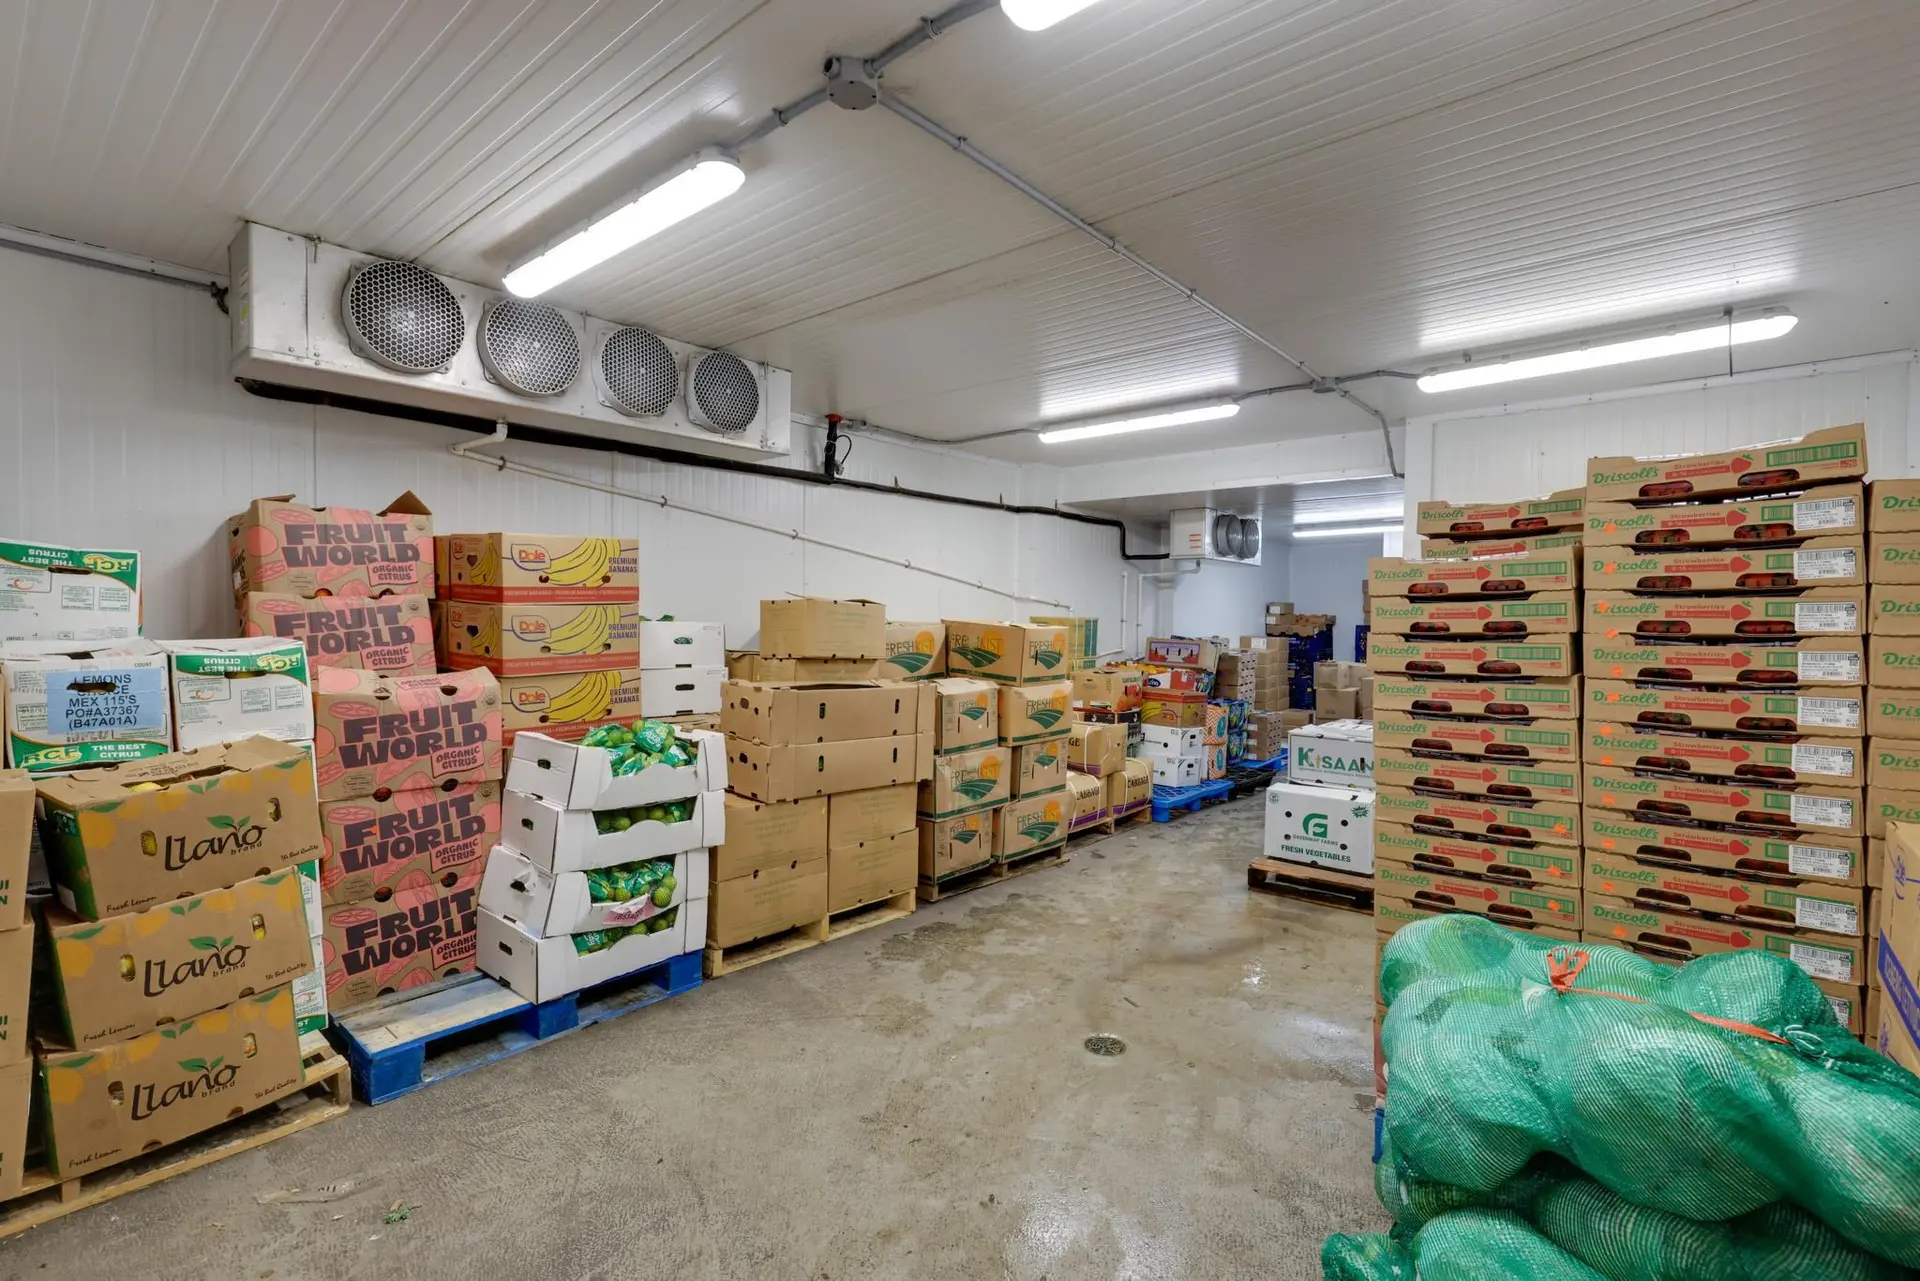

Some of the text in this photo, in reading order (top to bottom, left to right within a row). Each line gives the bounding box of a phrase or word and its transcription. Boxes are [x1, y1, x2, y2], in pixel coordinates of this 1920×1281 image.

[1673, 460, 1725, 469] Strawberries
[1592, 467, 1659, 484] Driscoll's
[1421, 510, 1465, 520] Driscoll's
[1589, 514, 1656, 530] Drscoll's
[283, 523, 408, 546] FRUIT
[28, 548, 68, 559] CITRUS
[281, 543, 421, 568] WORLD
[518, 549, 546, 561] Dole
[1426, 547, 1469, 557] Driscoll's
[20, 556, 74, 567] THE BEST
[608, 557, 638, 565] PREMIUM
[1592, 558, 1659, 573] Dscoll's
[372, 564, 414, 574] ORGANIC
[378, 571, 412, 581] CITRUS
[608, 565, 638, 573] BANANAS
[1373, 568, 1425, 580] Driscoll's
[1375, 606, 1425, 617] Driscoll's
[273, 605, 403, 638] FRUIT
[519, 620, 546, 631] Dole
[608, 623, 637, 631] PREMIUM
[608, 631, 637, 640] BANANAS
[365, 646, 409, 661] ORGANIC
[1371, 645, 1420, 656] Driscoll's
[1592, 648, 1660, 661] Driscoll's
[203, 657, 241, 665] CITRUS
[371, 655, 408, 667] CITRUS
[609, 687, 640, 696] PREMIUM
[1377, 683, 1428, 695] Driscoll's
[69, 694, 137, 708] MEX 115'S
[518, 691, 546, 703] Dole
[609, 695, 640, 705] BANANAS
[65, 705, 140, 719] PO#A37367
[68, 717, 137, 731] (B47A01A)
[343, 700, 477, 744] FRUIT
[1377, 721, 1428, 734] Driscoll's
[91, 743, 147, 752] THE BEST
[338, 722, 487, 769] WORLD
[1592, 734, 1660, 751] Driscoll's
[99, 750, 142, 759] CITRUS
[436, 746, 481, 763] ORGANIC
[442, 756, 478, 770] CITRUS
[1379, 757, 1431, 772] Driscoll's
[1592, 776, 1659, 794] Driscoll's
[1379, 795, 1430, 810] Driscoll's
[343, 794, 476, 849] FRUIT
[1592, 820, 1659, 840] Driscoll's
[230, 840, 263, 855] brand
[339, 815, 486, 874] WORLD
[435, 838, 479, 859] ORGANIC
[1320, 839, 1339, 847] FARMS
[1379, 833, 1429, 849] Driscoll's
[440, 849, 476, 864] CITRUS
[1281, 844, 1351, 863] FRESH VEGETABLES
[1379, 869, 1431, 886] Driscoll's
[1591, 863, 1659, 883] Driscoll's
[106, 895, 157, 913] Fresh Lemon
[345, 887, 476, 951] FRUIT
[1592, 905, 1660, 927] Driscoll's
[442, 942, 477, 960] CITRUS
[212, 960, 246, 978] brand
[83, 1022, 136, 1043] Fresh Lemon
[201, 1079, 236, 1098] brand
[69, 1148, 122, 1168] Fresh Lemon
